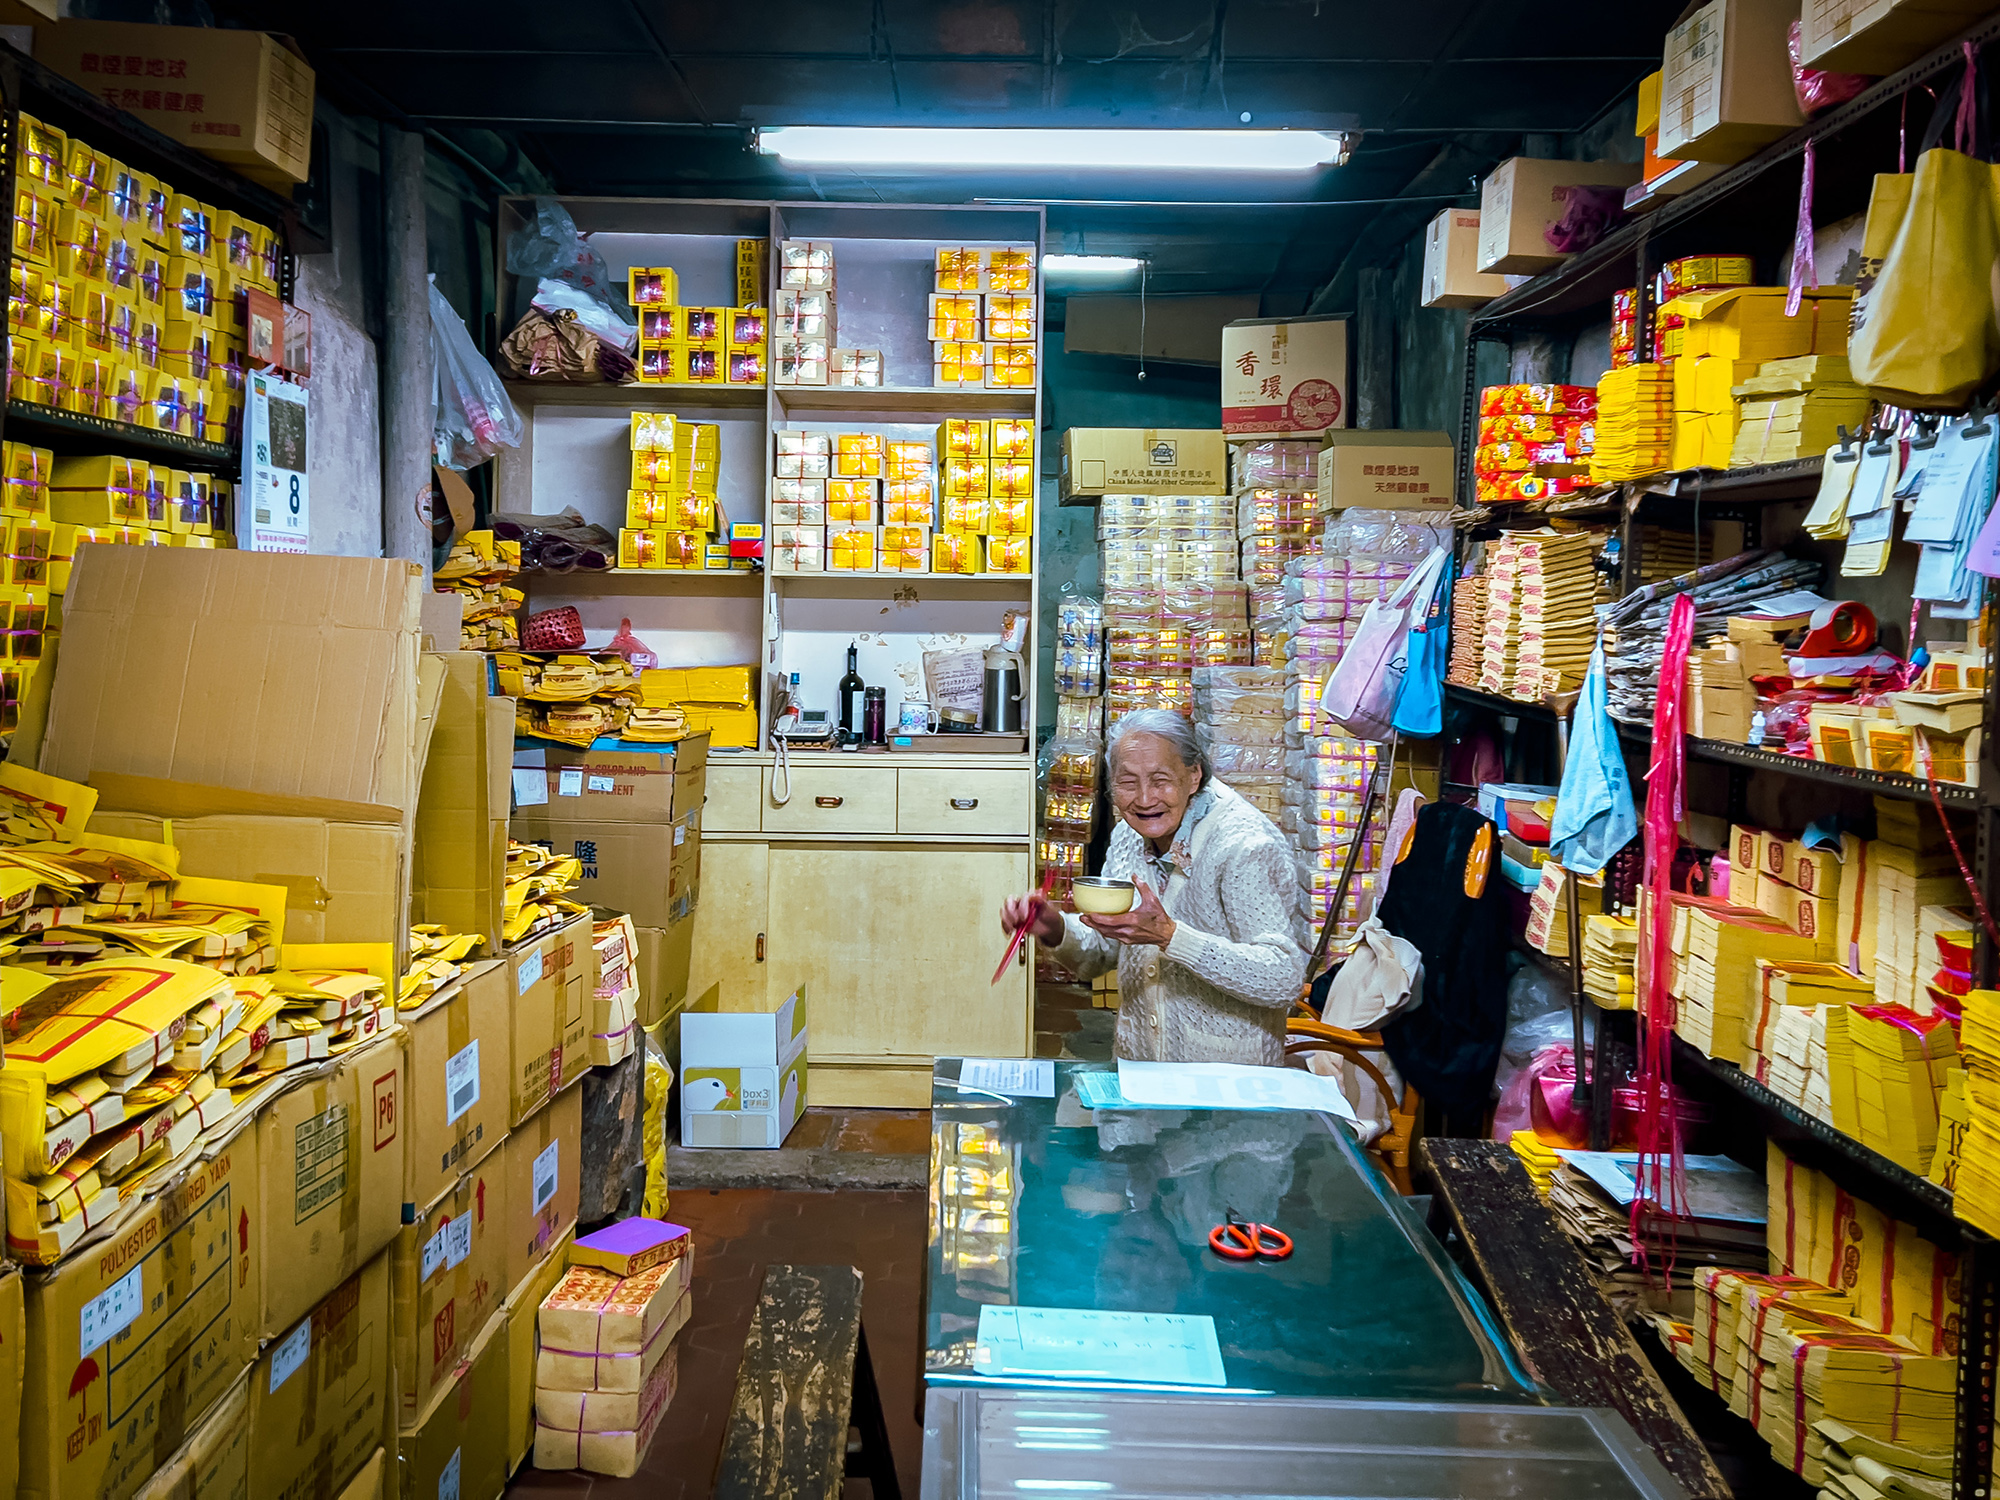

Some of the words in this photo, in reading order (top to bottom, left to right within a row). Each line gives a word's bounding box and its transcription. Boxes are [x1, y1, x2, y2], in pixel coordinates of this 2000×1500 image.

[289, 474, 300, 514] 8
[1161, 478, 1177, 486] Fiber
[1179, 479, 1216, 487] Corporation
[379, 1092, 393, 1129] P6
[742, 1089, 769, 1099] box3
[100, 1217, 157, 1280] POLYESTER
[209, 1153, 231, 1185] YARN
[239, 1255, 249, 1289] UP
[66, 1424, 85, 1464] KEEP
